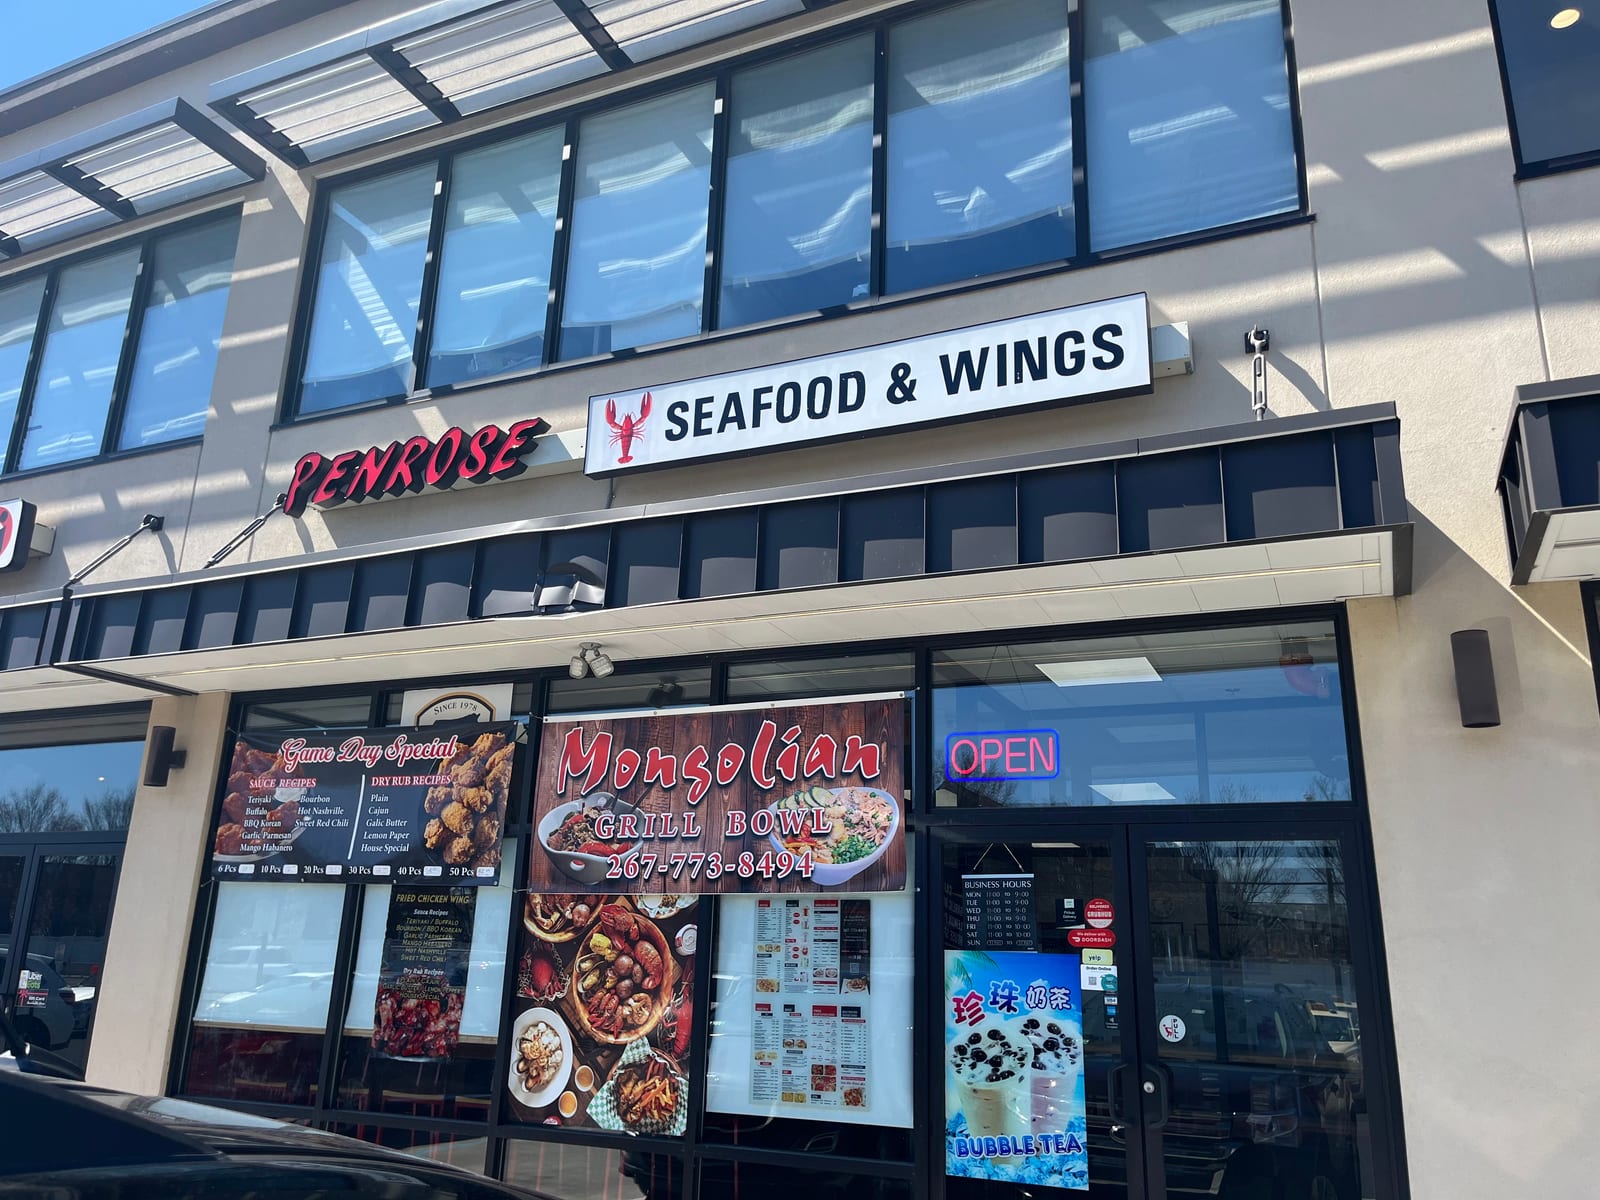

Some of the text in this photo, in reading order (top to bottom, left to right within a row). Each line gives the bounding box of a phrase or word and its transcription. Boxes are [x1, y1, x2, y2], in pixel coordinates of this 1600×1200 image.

[664, 323, 1125, 441] SEAFOOD & WINGS
[283, 416, 550, 517] PENROSE
[460, 702, 478, 712] 1978
[282, 734, 458, 773] Game Day Special
[951, 737, 1054, 775] OPEN
[557, 720, 880, 805] Mongolian
[249, 778, 276, 788] SAUCE
[372, 775, 452, 786] DRY RUB RECIPES
[248, 795, 272, 806] Teriyaki
[300, 795, 330, 803] Bourbon
[370, 794, 388, 802] Plain
[246, 808, 268, 816] Buffalo
[298, 807, 344, 815] Hot Nashville
[368, 806, 389, 816] Cajun
[244, 820, 259, 829] BBQ
[295, 819, 349, 827] Sweet Red Chili
[366, 819, 408, 827] Galic Butter
[594, 808, 833, 839] GRILL BOWL
[364, 831, 410, 841] Lemon Paper
[240, 844, 293, 854] Mango Habanero
[361, 843, 410, 854] House Special
[218, 864, 224, 873] 6
[224, 864, 237, 874] Pcs
[260, 865, 268, 874] 10
[269, 865, 281, 874] Pcs
[304, 865, 312, 874] 20
[313, 865, 324, 874] Pcs
[606, 851, 814, 879] 267-773-8494
[348, 866, 358, 875] 30
[359, 866, 371, 875] Pcs
[396, 866, 407, 876] 40
[408, 866, 422, 876] Pcs
[448, 866, 460, 876] 50
[461, 866, 474, 876] Pcs
[396, 894, 470, 904] FRIED CHICKEN WING
[955, 1134, 1083, 1158] BUBBLE TEA
